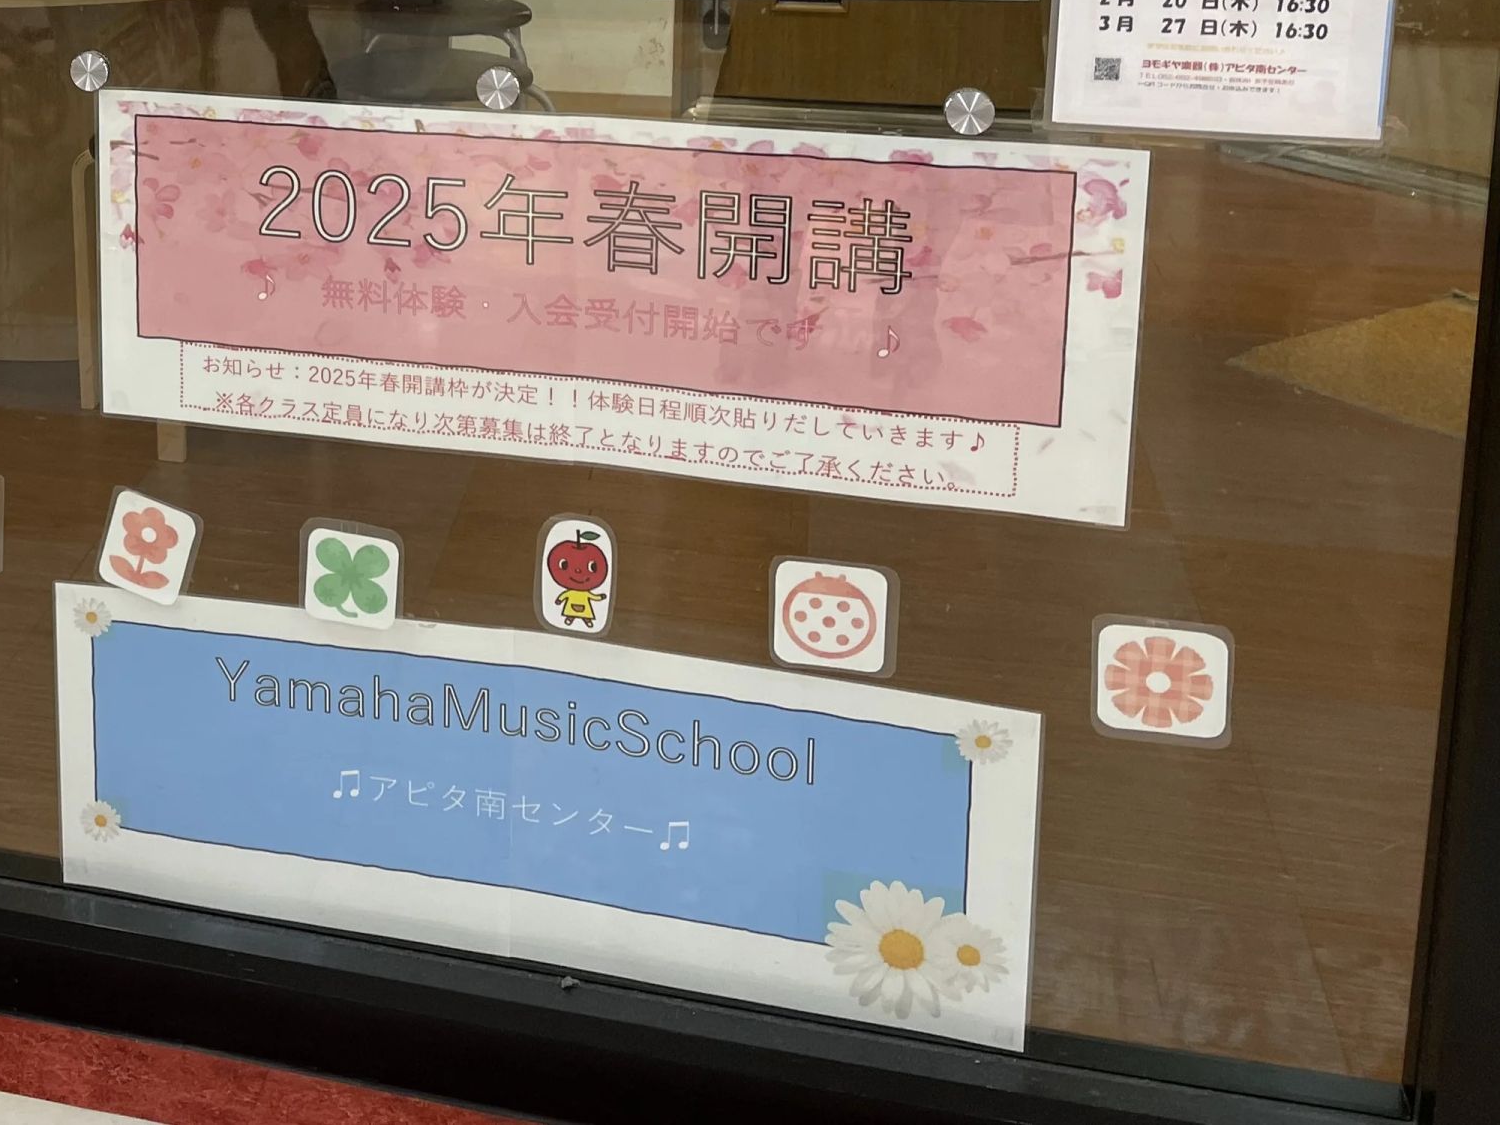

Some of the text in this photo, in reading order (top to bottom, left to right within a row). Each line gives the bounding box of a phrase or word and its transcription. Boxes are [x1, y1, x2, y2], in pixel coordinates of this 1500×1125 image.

[1099, 16, 1134, 33] 3月
[1161, 18, 1186, 34] 27
[1274, 21, 1328, 40] 16:30
[257, 164, 914, 295] 2025年春開講
[215, 656, 817, 787] YamahaMusicSchool
